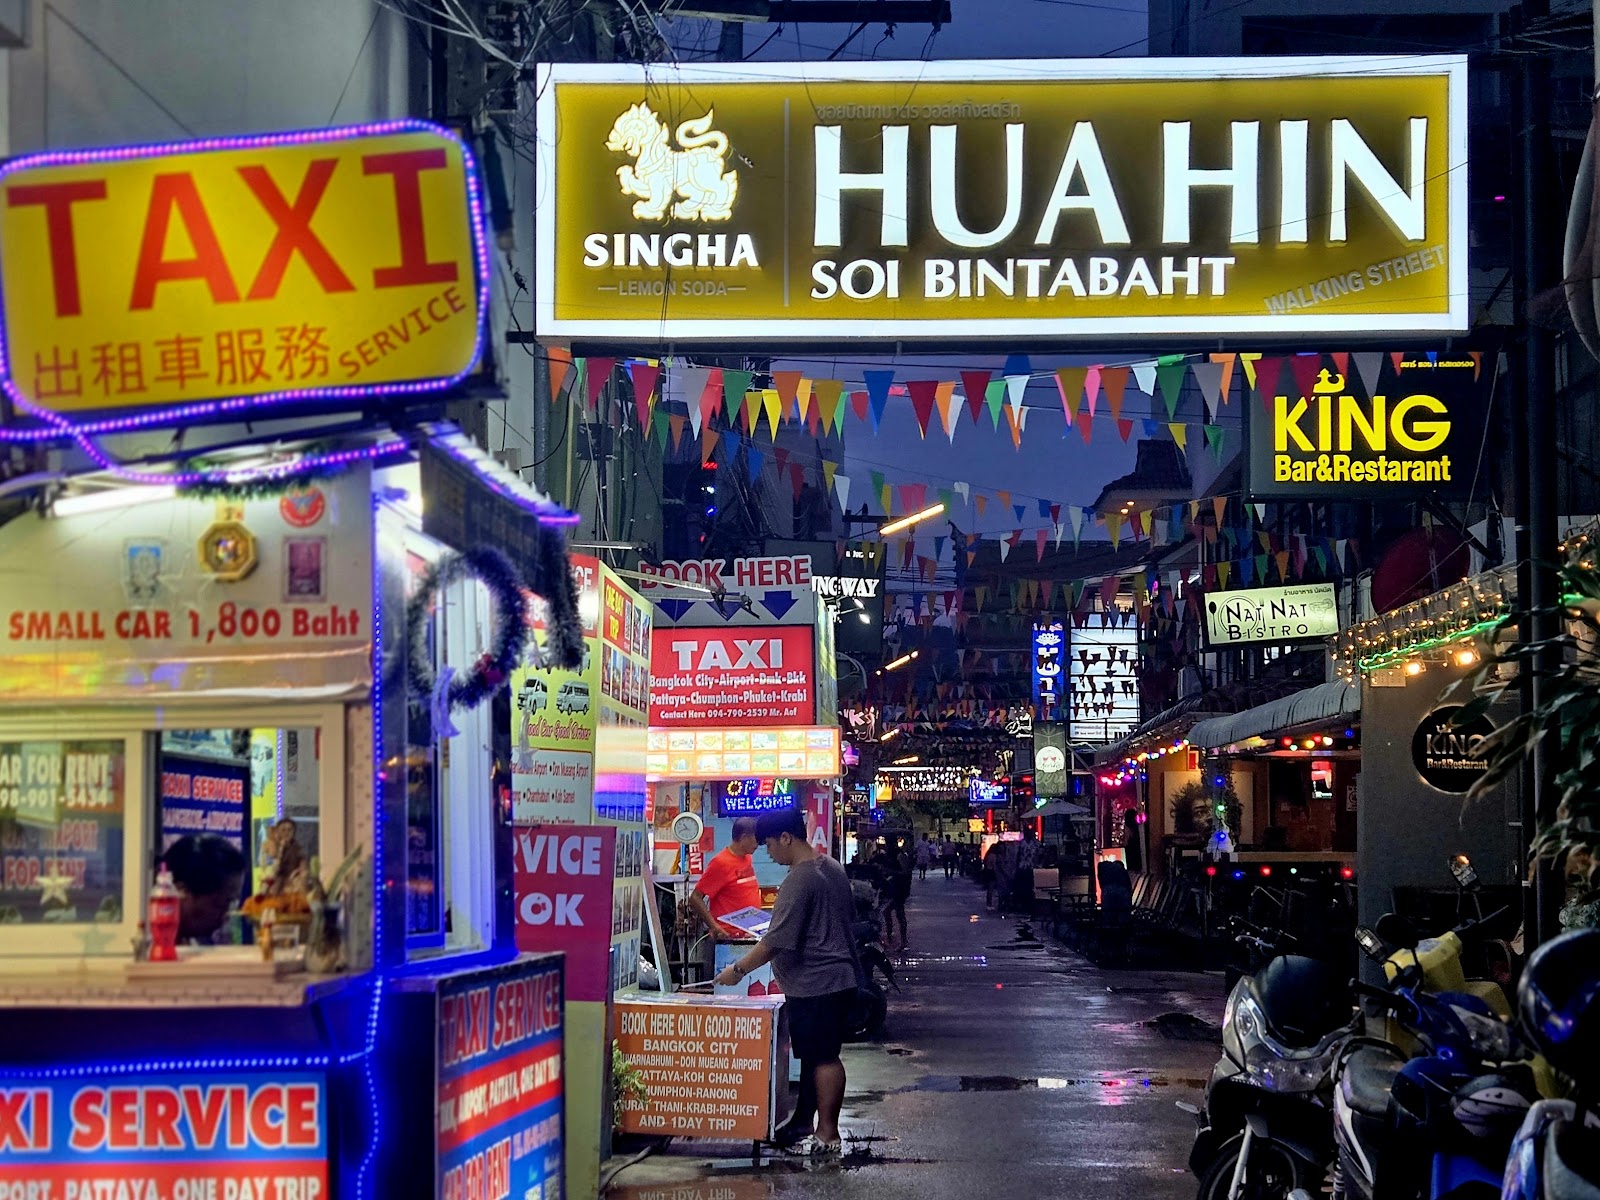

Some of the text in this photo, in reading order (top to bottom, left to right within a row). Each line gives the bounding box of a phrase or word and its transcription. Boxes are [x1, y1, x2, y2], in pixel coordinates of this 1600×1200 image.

[7, 147, 459, 318] TAXI
[583, 233, 760, 269] SINGHA
[619, 281, 727, 296] LEMON SODA
[811, 257, 1236, 300] SOI BINTABAHT
[1264, 245, 1446, 316] WALKING STREET
[338, 286, 467, 378] SERVICE
[34, 323, 331, 400] 出租車服務
[1274, 394, 1452, 452] KING
[1274, 454, 1452, 482] Bar&Restarant
[639, 558, 811, 589] BOOK HERE
[9, 602, 360, 644] SMALL CAR 1,800 Baht
[672, 638, 783, 671] TAXI
[650, 674, 694, 691] Bangkok
[660, 710, 687, 719] Contact
[688, 710, 706, 718] Here
[727, 778, 790, 797] OPEN
[725, 796, 792, 811] WELCOME
[441, 969, 561, 1069] TAXI SERVICE
[621, 1012, 762, 1040] BOOK HERE ONLY GOOD PRICE
[643, 1039, 739, 1055] BANGKOK CITY
[680, 1056, 696, 1068] DON
[699, 1057, 729, 1070] MUEANG
[731, 1058, 763, 1071] AIRPORT
[708, 1073, 743, 1085] CHANG
[68, 1083, 320, 1151] SERVICE
[639, 1115, 737, 1131] AND 1DAY TRIP
[654, 1101, 759, 1116] THANI-KRABI-PHUKET
